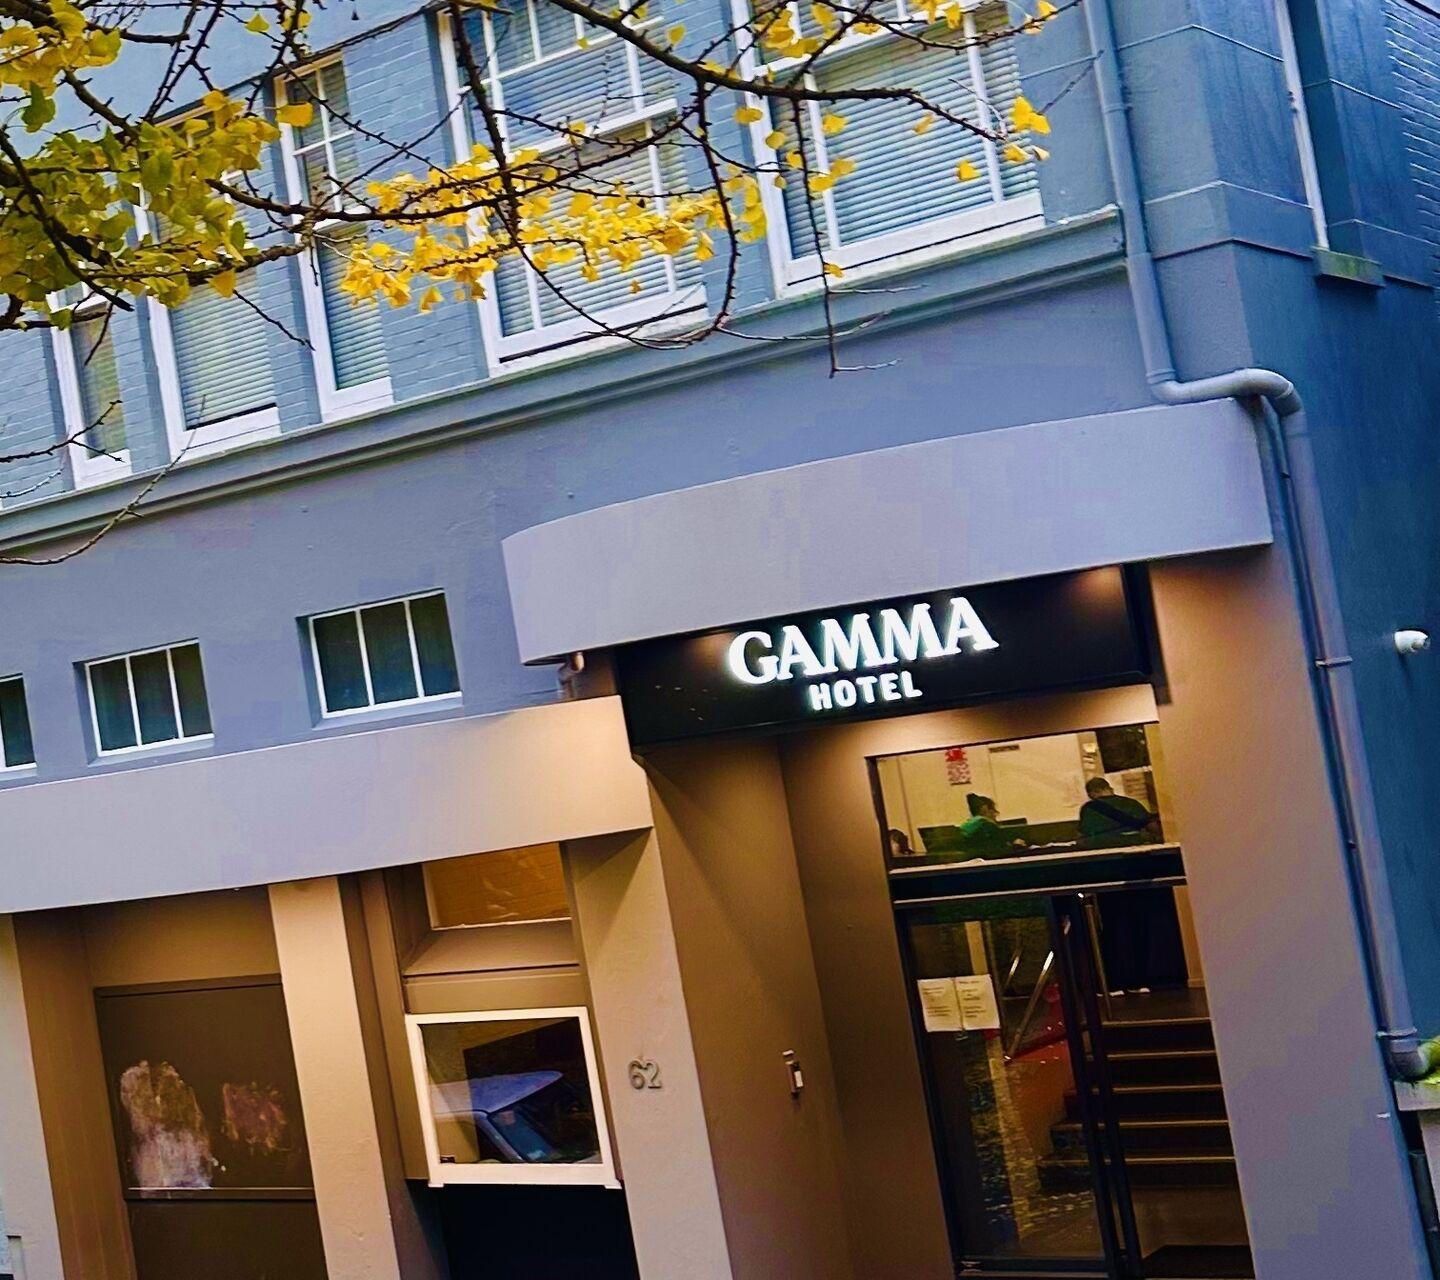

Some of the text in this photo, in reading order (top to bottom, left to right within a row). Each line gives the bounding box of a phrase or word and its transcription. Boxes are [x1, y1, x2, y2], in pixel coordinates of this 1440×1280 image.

[728, 596, 1000, 685] GAMMA
[809, 670, 923, 711] HOTEL
[628, 1060, 662, 1090] 62
